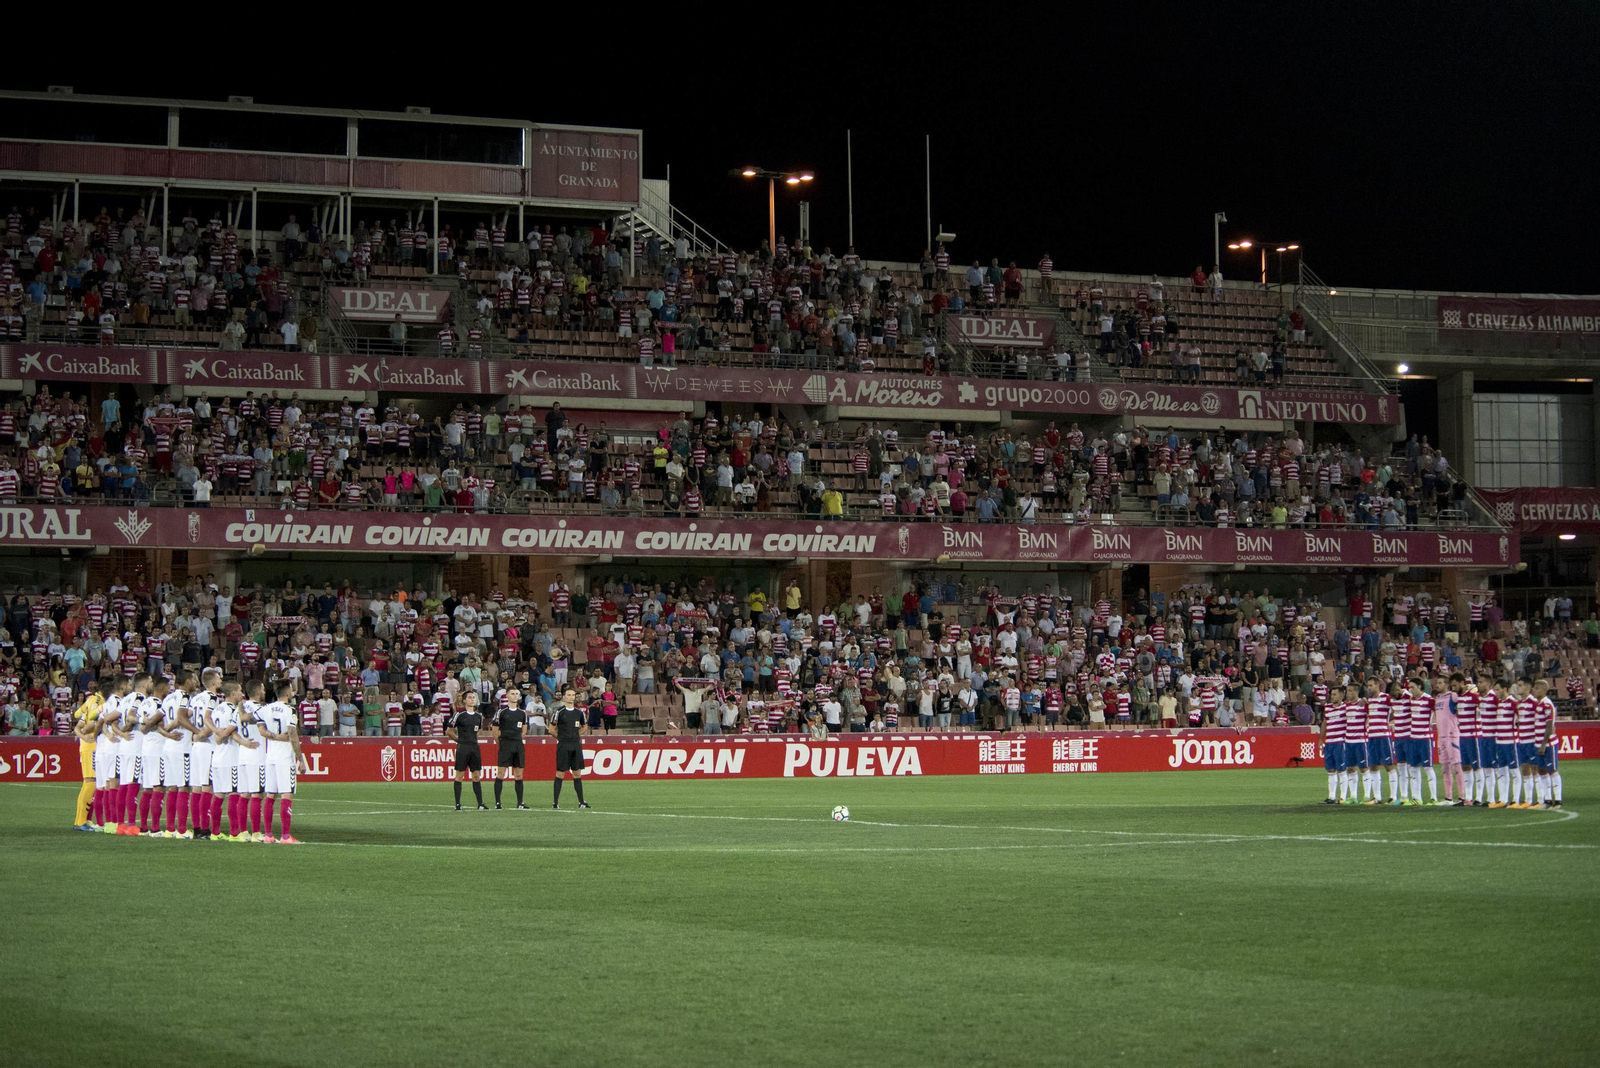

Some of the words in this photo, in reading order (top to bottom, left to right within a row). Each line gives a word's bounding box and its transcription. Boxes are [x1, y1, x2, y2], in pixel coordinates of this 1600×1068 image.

[581, 161, 597, 172] DE
[342, 290, 436, 313] IDEAL
[959, 318, 1042, 341] IDEAL
[1466, 313, 1534, 331] CERVEZAS
[47, 354, 141, 375] CaixaBank
[212, 360, 305, 380] CaixaBank
[530, 370, 621, 390] CaixaBank
[880, 378, 942, 391] AUTOCARES
[1308, 392, 1365, 401] COMERCIAL
[1263, 401, 1366, 423] NEPTUNO
[1522, 504, 1588, 520] CERVEZAS
[943, 531, 982, 547] BMN
[1018, 533, 1057, 548] BMN
[1092, 533, 1130, 549] BMN
[1165, 535, 1202, 550] BMN
[1236, 536, 1272, 551] BMN
[1305, 537, 1340, 552] BMN
[1373, 539, 1407, 553] BMN
[1439, 539, 1472, 553] BMN
[194, 706, 204, 728] 15
[273, 718, 281, 735] 7
[979, 740, 1026, 761] 能量王
[1053, 739, 1098, 760] 能量王
[784, 744, 923, 777] PULEVA
[980, 764, 1005, 773] ENERGY
[1008, 764, 1024, 773] KING
[1053, 763, 1078, 772] ENERGY
[1081, 762, 1097, 771] KING
[411, 766, 444, 779] CLUB
